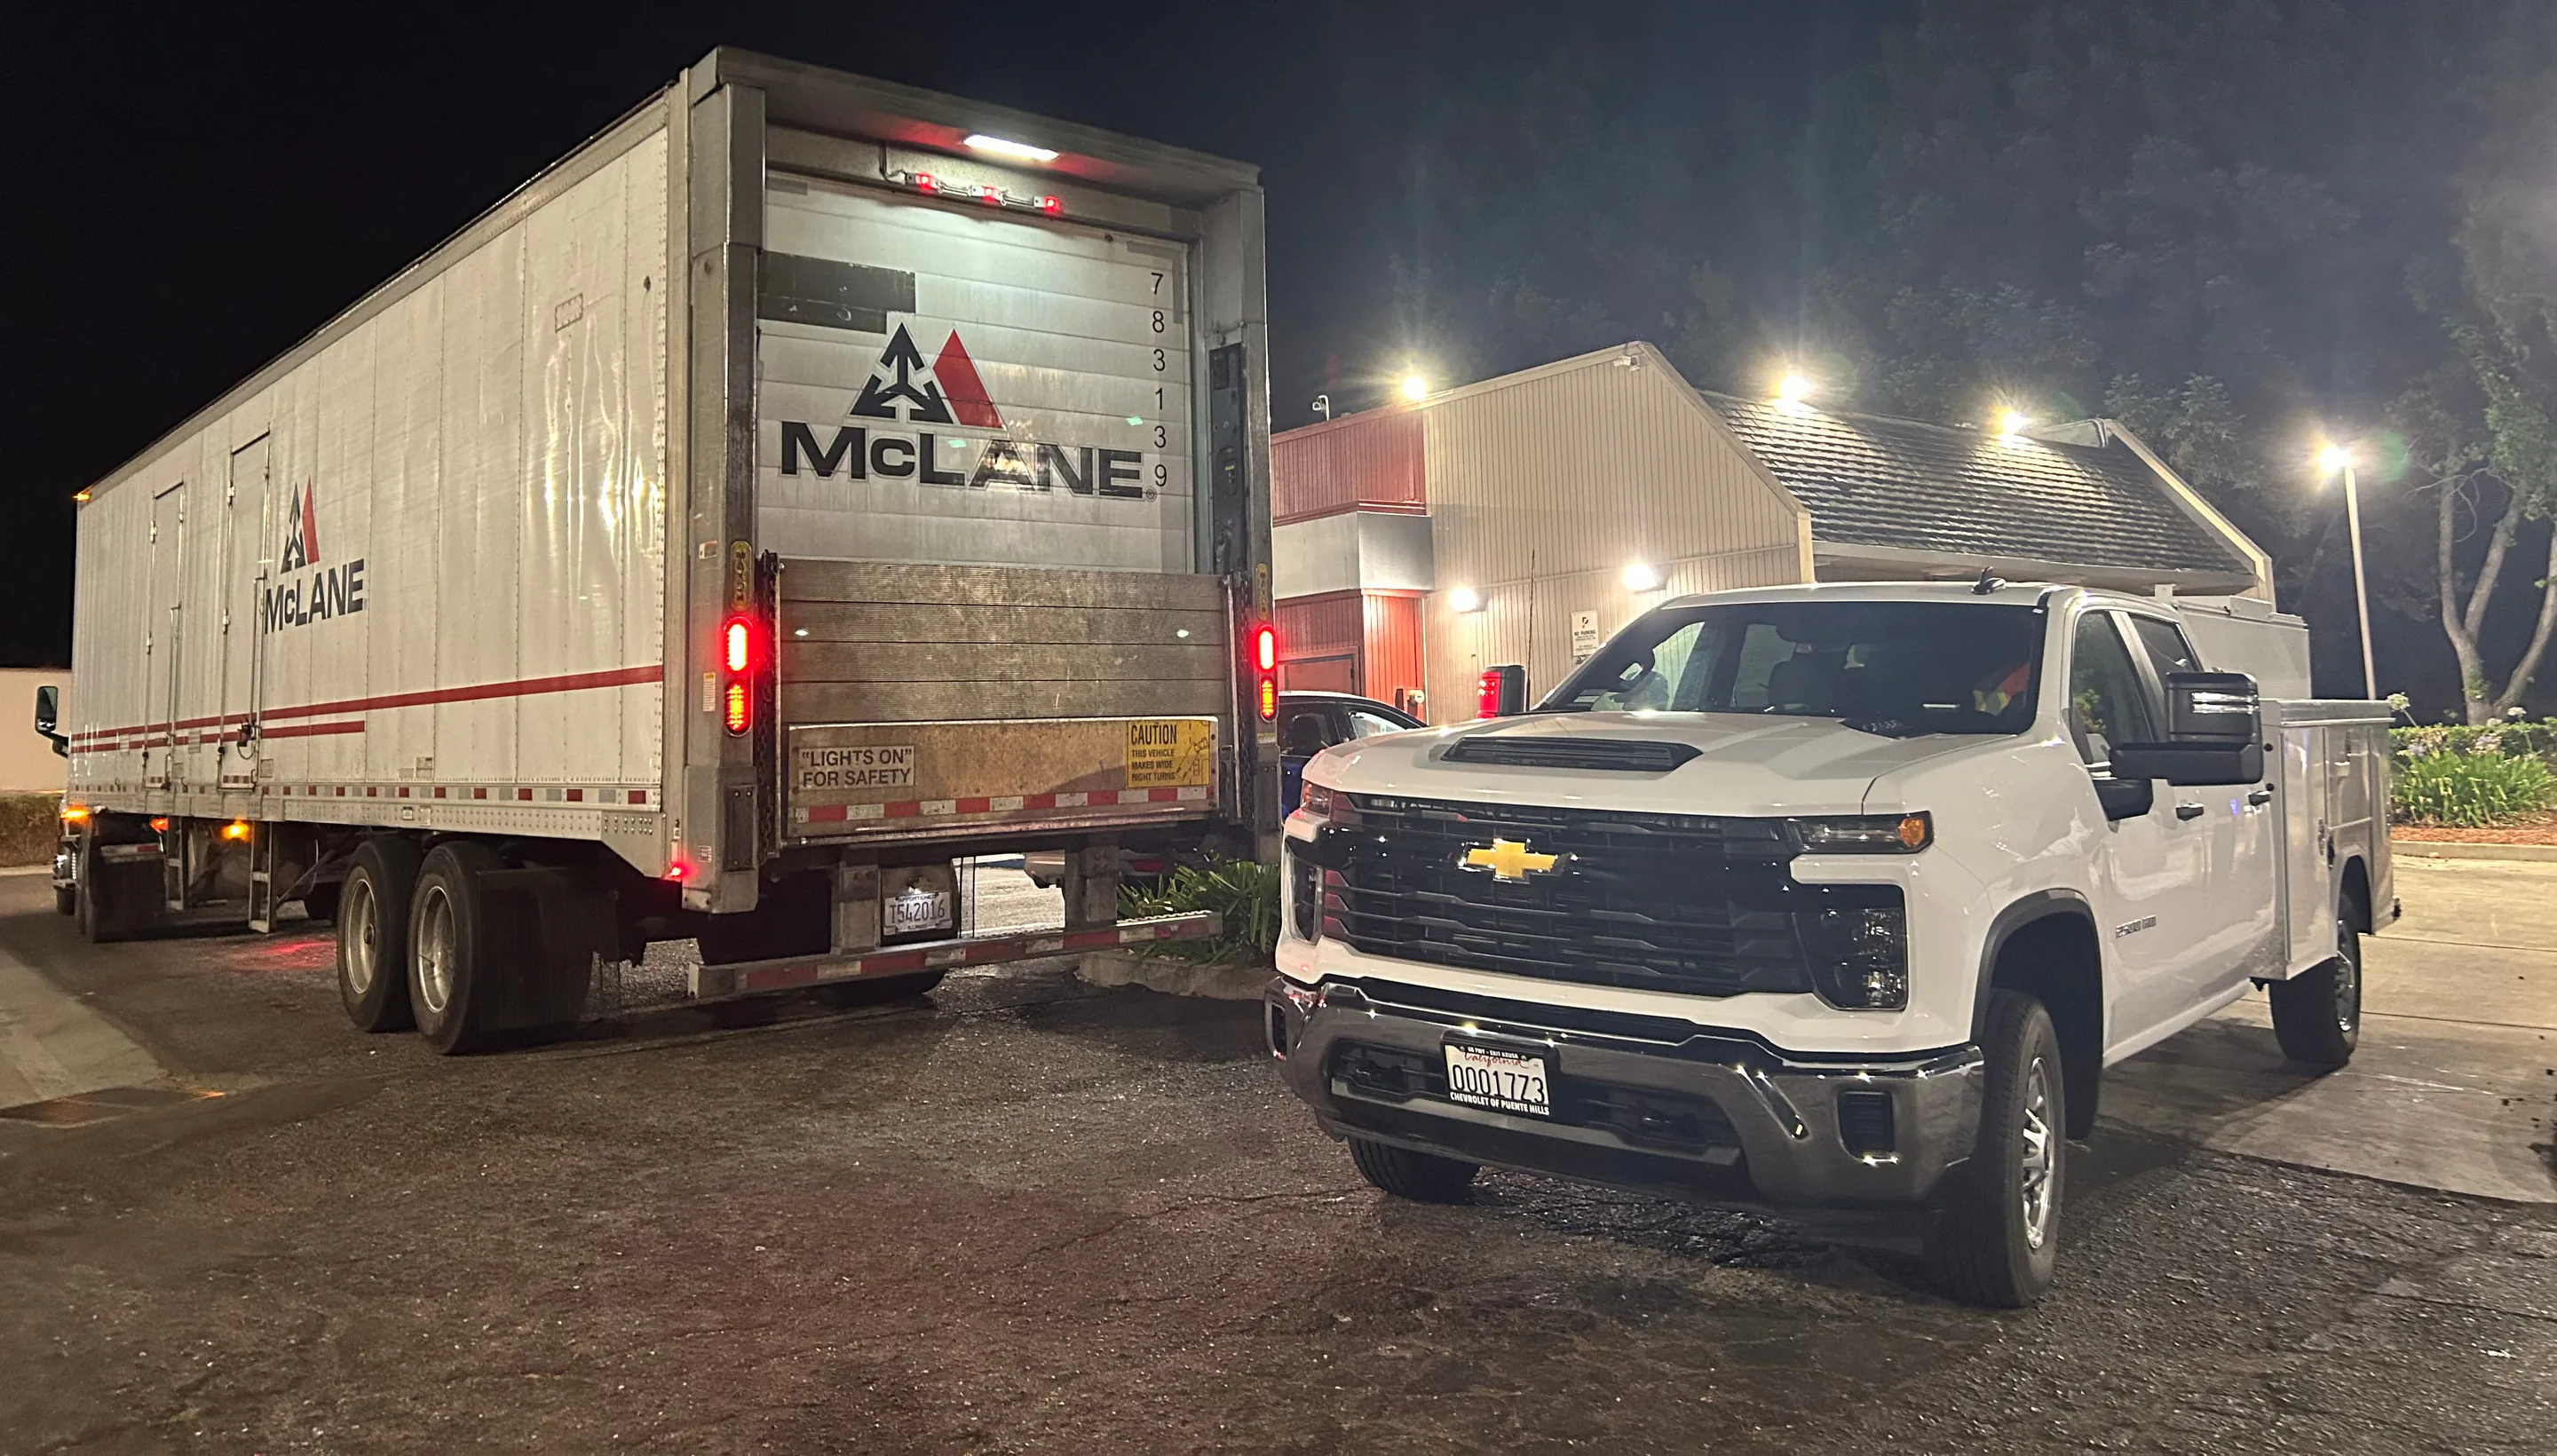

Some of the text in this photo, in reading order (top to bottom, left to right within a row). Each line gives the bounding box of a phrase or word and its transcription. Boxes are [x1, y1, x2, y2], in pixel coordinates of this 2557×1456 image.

[781, 421, 1144, 499] McLANE
[265, 558, 365, 634] McLANE
[1130, 724, 1177, 745] CAUTION
[1131, 748, 1175, 758] THIS VEHICLE
[1131, 760, 1173, 770] MAKES WIDE
[803, 768, 912, 787] FOR SAFETY
[1131, 772, 1176, 781] RIGHT TURNS
[890, 898, 946, 924] T542016
[1450, 1091, 1550, 1116] CHEVROLET OF PUENTE HILLS
